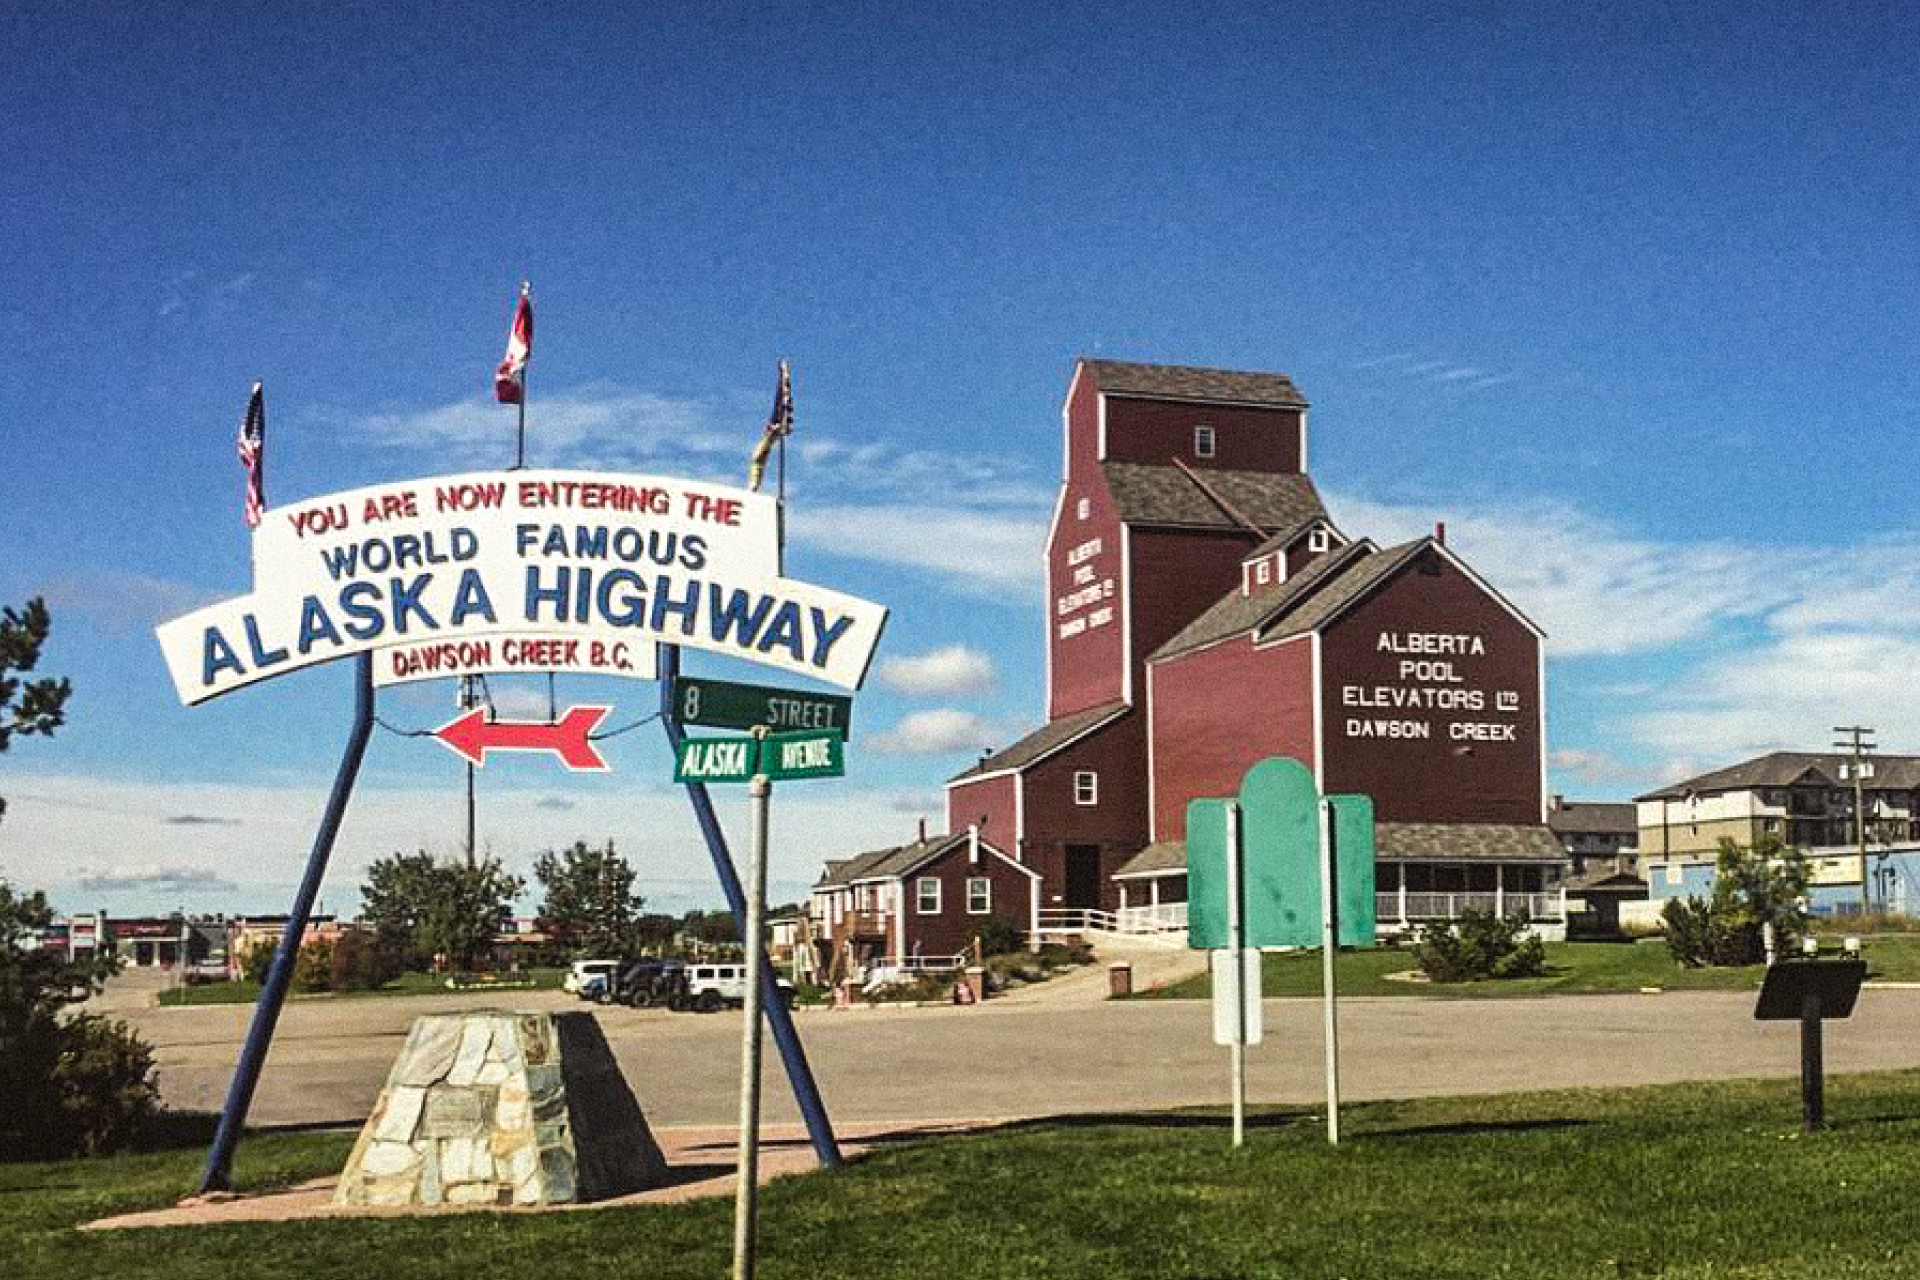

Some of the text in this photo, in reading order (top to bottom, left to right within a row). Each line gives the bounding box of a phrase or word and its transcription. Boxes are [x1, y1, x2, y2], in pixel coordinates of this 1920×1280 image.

[287, 482, 743, 538] YOU ARE NOW ENTERING THE
[320, 523, 708, 580] WORLD FAMOUS
[202, 564, 855, 685] ALASKA HIGHWAY
[1377, 632, 1485, 655] ALBERTA
[392, 638, 634, 676] DAWSON CREEK B.C.
[1400, 660, 1464, 682] POOL
[683, 685, 837, 727] 8 STREET
[1342, 685, 1485, 711] ELEVATORS
[1346, 718, 1517, 741] DAWSON CREEK
[681, 738, 833, 777] ALASKA AVENUE
